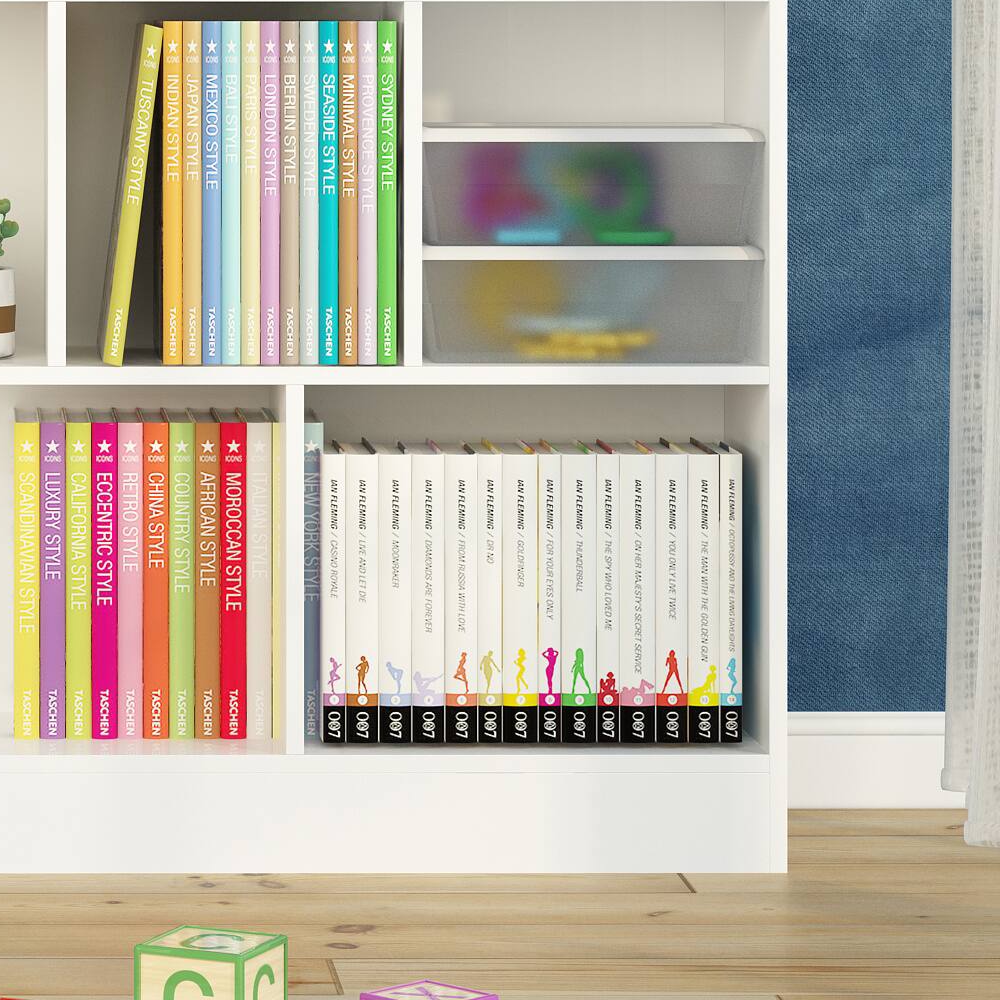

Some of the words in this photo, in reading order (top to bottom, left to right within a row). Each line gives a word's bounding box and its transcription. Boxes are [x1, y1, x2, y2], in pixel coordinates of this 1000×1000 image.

[167, 74, 179, 127] INDIAN
[186, 73, 198, 127] JAPAN
[206, 74, 218, 136] MEXICO
[226, 74, 237, 108] BALI
[264, 74, 276, 142] LONDON
[284, 74, 296, 130] BERLIN
[322, 73, 335, 140] SEASIDE
[343, 74, 354, 143] MINIMAL
[381, 73, 393, 137] SYDNEY
[134, 79, 154, 153] TUSCANY
[226, 114, 237, 163] STYLE
[362, 74, 374, 160] PROVENCE
[127, 157, 148, 205] STYLE
[167, 133, 179, 182] STYLE
[186, 132, 198, 181] STYLE
[206, 141, 218, 190] STYLE
[264, 148, 276, 196] STYLE
[284, 136, 296, 184] STYLE
[322, 146, 335, 195] STYLE
[343, 148, 354, 198] STYLE
[381, 141, 393, 191] STYLE
[362, 165, 374, 213] STYLE
[169, 307, 177, 357] TASCHEN
[208, 307, 216, 357] TASCHEN
[345, 307, 353, 357] TASCHEN
[45, 472, 60, 529] LUXURY
[122, 472, 138, 521] RETRO
[148, 472, 164, 518] CHINA
[174, 472, 190, 543] COUNTRY
[200, 472, 216, 536] AFRICAN
[304, 472, 319, 507] NEW
[330, 479, 338, 493] IAN
[19, 472, 35, 583] SCANDINAVIAN
[71, 472, 86, 560] CALIFORNIA
[96, 472, 112, 556] ECCENTRIC
[226, 472, 241, 560] MOROCCAN
[304, 512, 319, 551] YORK
[330, 495, 338, 530] FLEMING
[45, 535, 60, 579] STYLE
[122, 526, 138, 572] STYLE
[148, 523, 164, 568] STYLE
[174, 548, 190, 592] STYLE
[200, 541, 216, 586] STYLE
[71, 565, 86, 610] STYLE
[96, 560, 112, 606] STYLE
[226, 565, 241, 611] STYLE
[304, 556, 319, 602] STYLE
[19, 588, 35, 632] STYLE
[22, 689, 32, 735] TASCHEN
[100, 689, 109, 735] TASCHEN
[177, 689, 187, 735] TASCHEN
